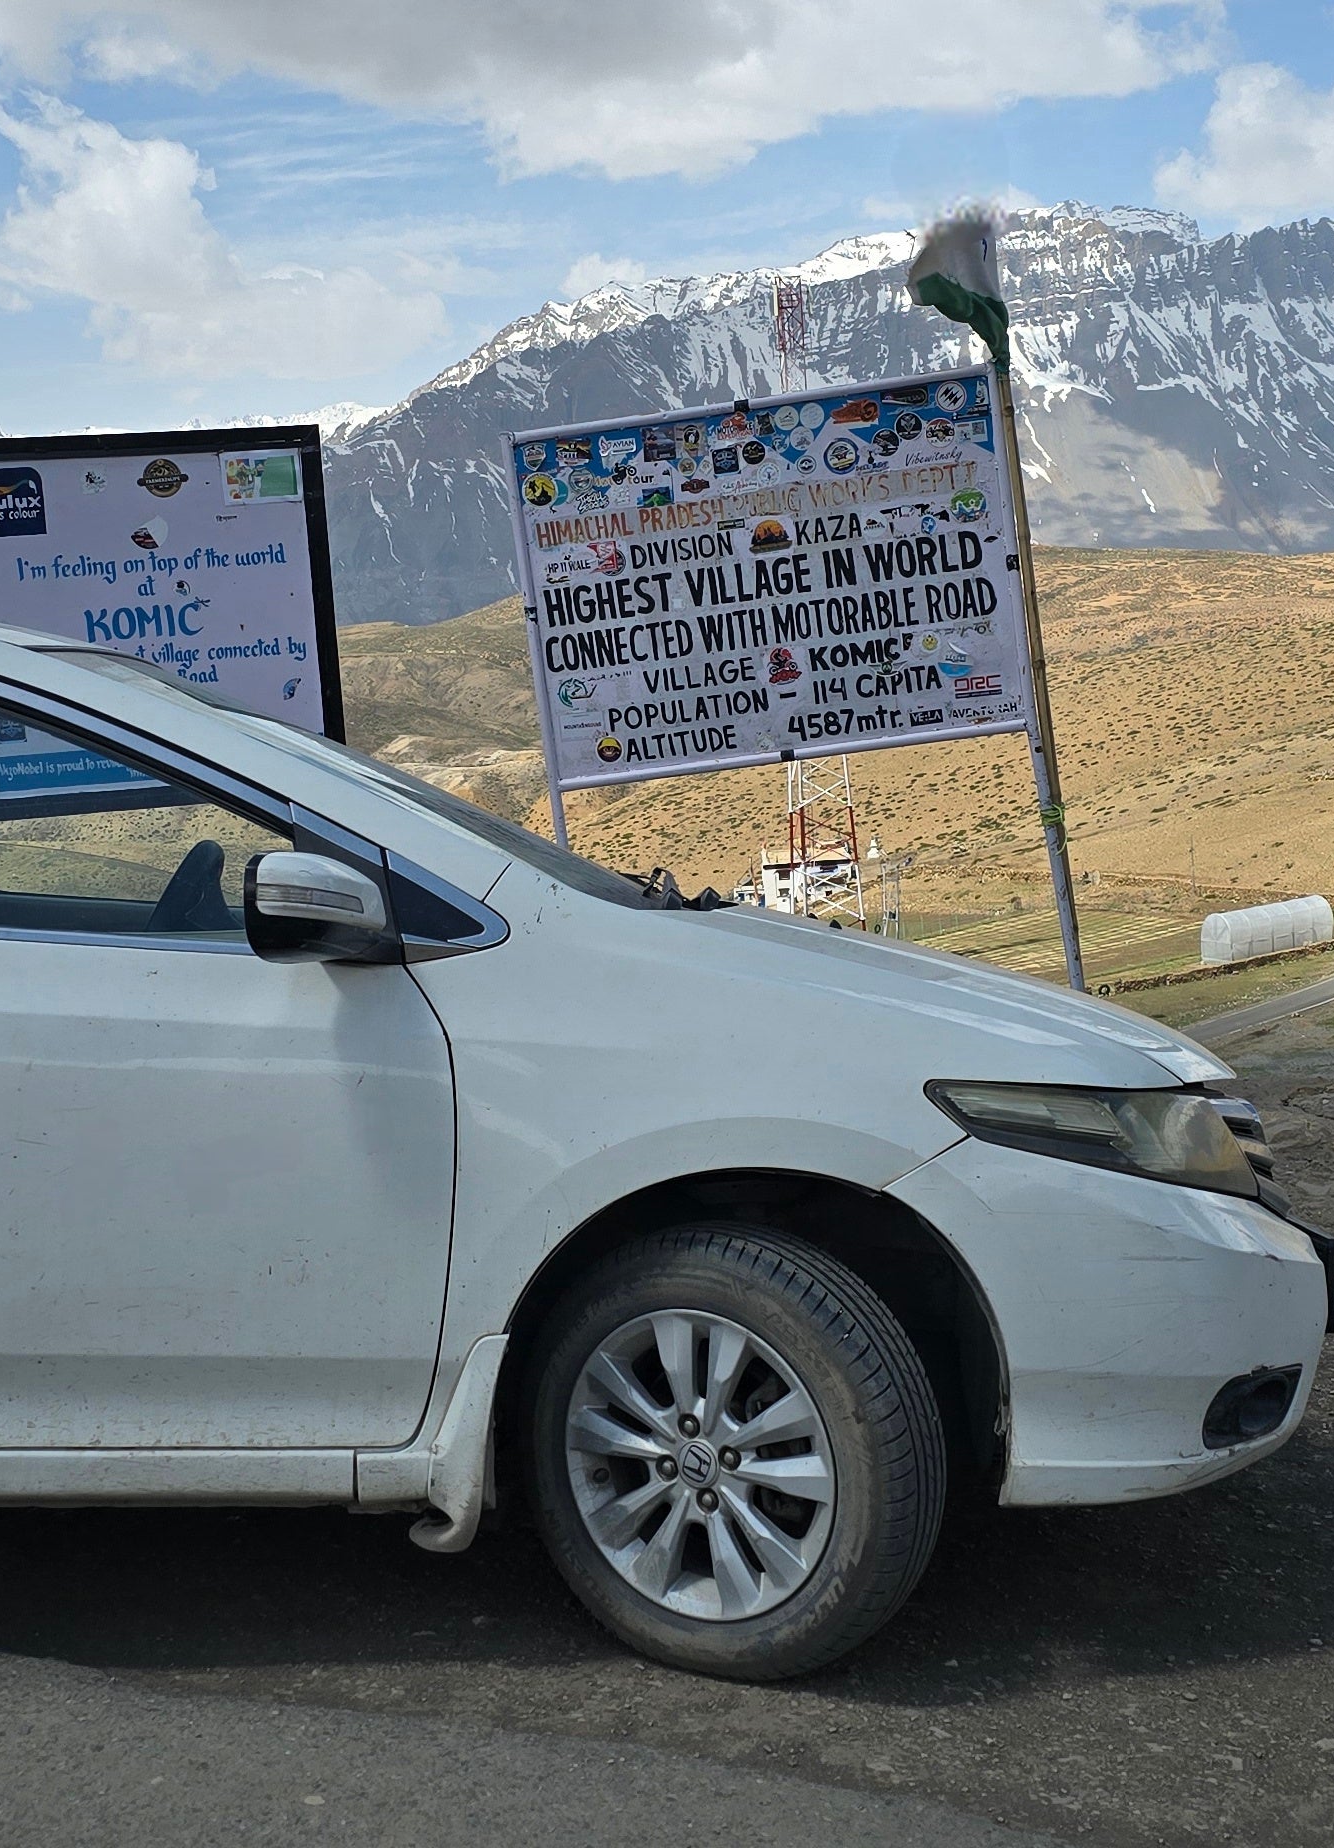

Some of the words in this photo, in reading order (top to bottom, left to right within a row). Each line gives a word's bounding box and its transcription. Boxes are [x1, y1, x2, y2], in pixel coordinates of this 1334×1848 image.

[8, 508, 40, 520] colour
[535, 511, 635, 549] HIMACHAL
[638, 497, 725, 534] PRADESH
[629, 531, 735, 570] DIVISION
[794, 513, 863, 547] KAZA
[16, 557, 47, 582] I'm
[51, 554, 117, 585] feeling
[123, 557, 145, 574] on
[148, 551, 179, 577] top
[183, 549, 202, 570] of
[204, 549, 230, 569] the
[235, 542, 287, 568] world
[542, 572, 673, 628] HIGHEST
[683, 553, 813, 608] VILLAGE
[822, 547, 858, 589] IN
[862, 530, 984, 583] WORLD
[137, 575, 156, 597] at
[83, 602, 204, 644] KOMIC
[545, 619, 694, 673] CONNECTED
[696, 607, 768, 653] WITH
[770, 587, 920, 645] MOTORABLE
[924, 576, 998, 624] ROAD
[151, 642, 200, 670] village
[207, 638, 282, 661] connected
[286, 637, 307, 662] by
[642, 656, 756, 694] VILLAGE
[808, 637, 902, 672] KOMIC
[608, 687, 770, 733] POPULATION
[812, 677, 848, 704] 114
[855, 664, 943, 698] CAPITA
[626, 725, 738, 763] ALTITUDE
[46, 762, 55, 774] is
[57, 758, 84, 776] proud
[86, 757, 95, 770] to
